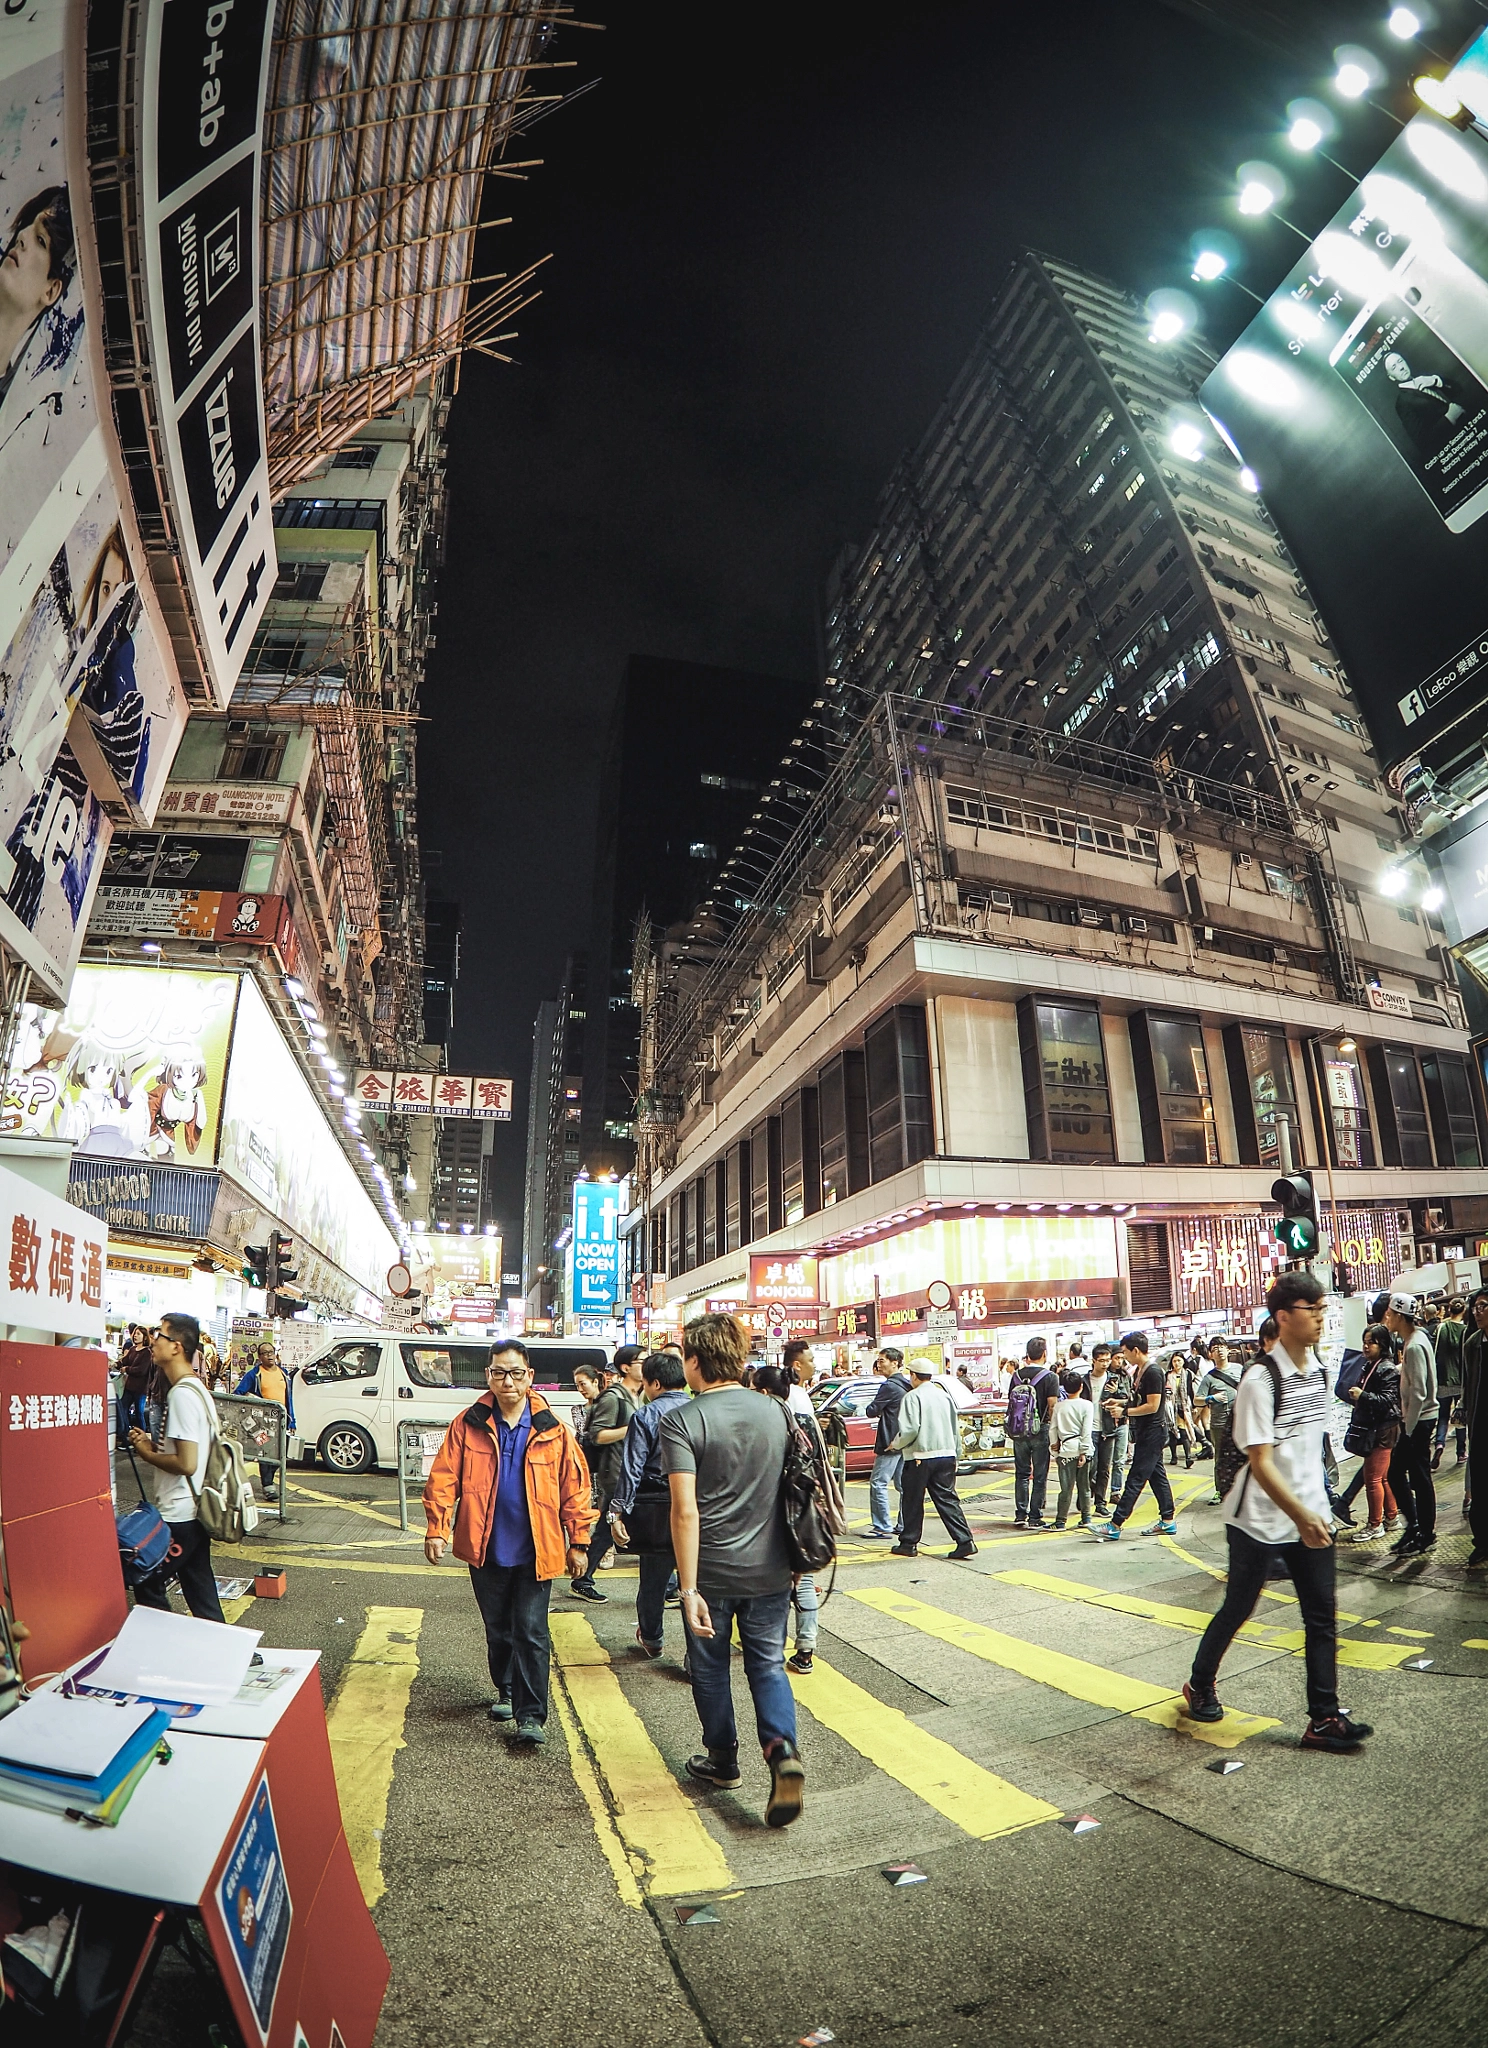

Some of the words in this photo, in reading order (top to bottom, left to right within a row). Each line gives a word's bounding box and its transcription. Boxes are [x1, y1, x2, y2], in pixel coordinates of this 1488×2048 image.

[179, 213, 200, 317] MUSIUM
[1355, 357, 1379, 384] HOUSE
[1385, 316, 1410, 345] CARDS
[205, 366, 236, 510] izzue
[1424, 455, 1440, 470] Catch
[1448, 429, 1467, 447] Season
[1451, 431, 1476, 454] December
[1441, 456, 1461, 475] Monday
[1463, 439, 1479, 454] Friday
[1442, 477, 1460, 494] Season
[1461, 459, 1481, 477] coming
[1426, 671, 1457, 699] LeEco
[159, 791, 219, 814] 州賓館
[222, 789, 265, 801] GUANGCHOW
[265, 792, 286, 803] HOTEL
[1381, 992, 1406, 1006] CONVEY
[105, 1206, 149, 1228] SHOPPING
[154, 1212, 191, 1233] CENTRE
[8, 1213, 102, 1308] 數碼通
[576, 1242, 616, 1257] NOW
[575, 1257, 615, 1271] OPEN
[589, 1274, 607, 1285] 1/F
[756, 1285, 815, 1299] BONJOUR
[1028, 1296, 1089, 1313] BONJOUR
[232, 1319, 262, 1329] CASIO
[886, 1307, 918, 1326] BONJOUR
